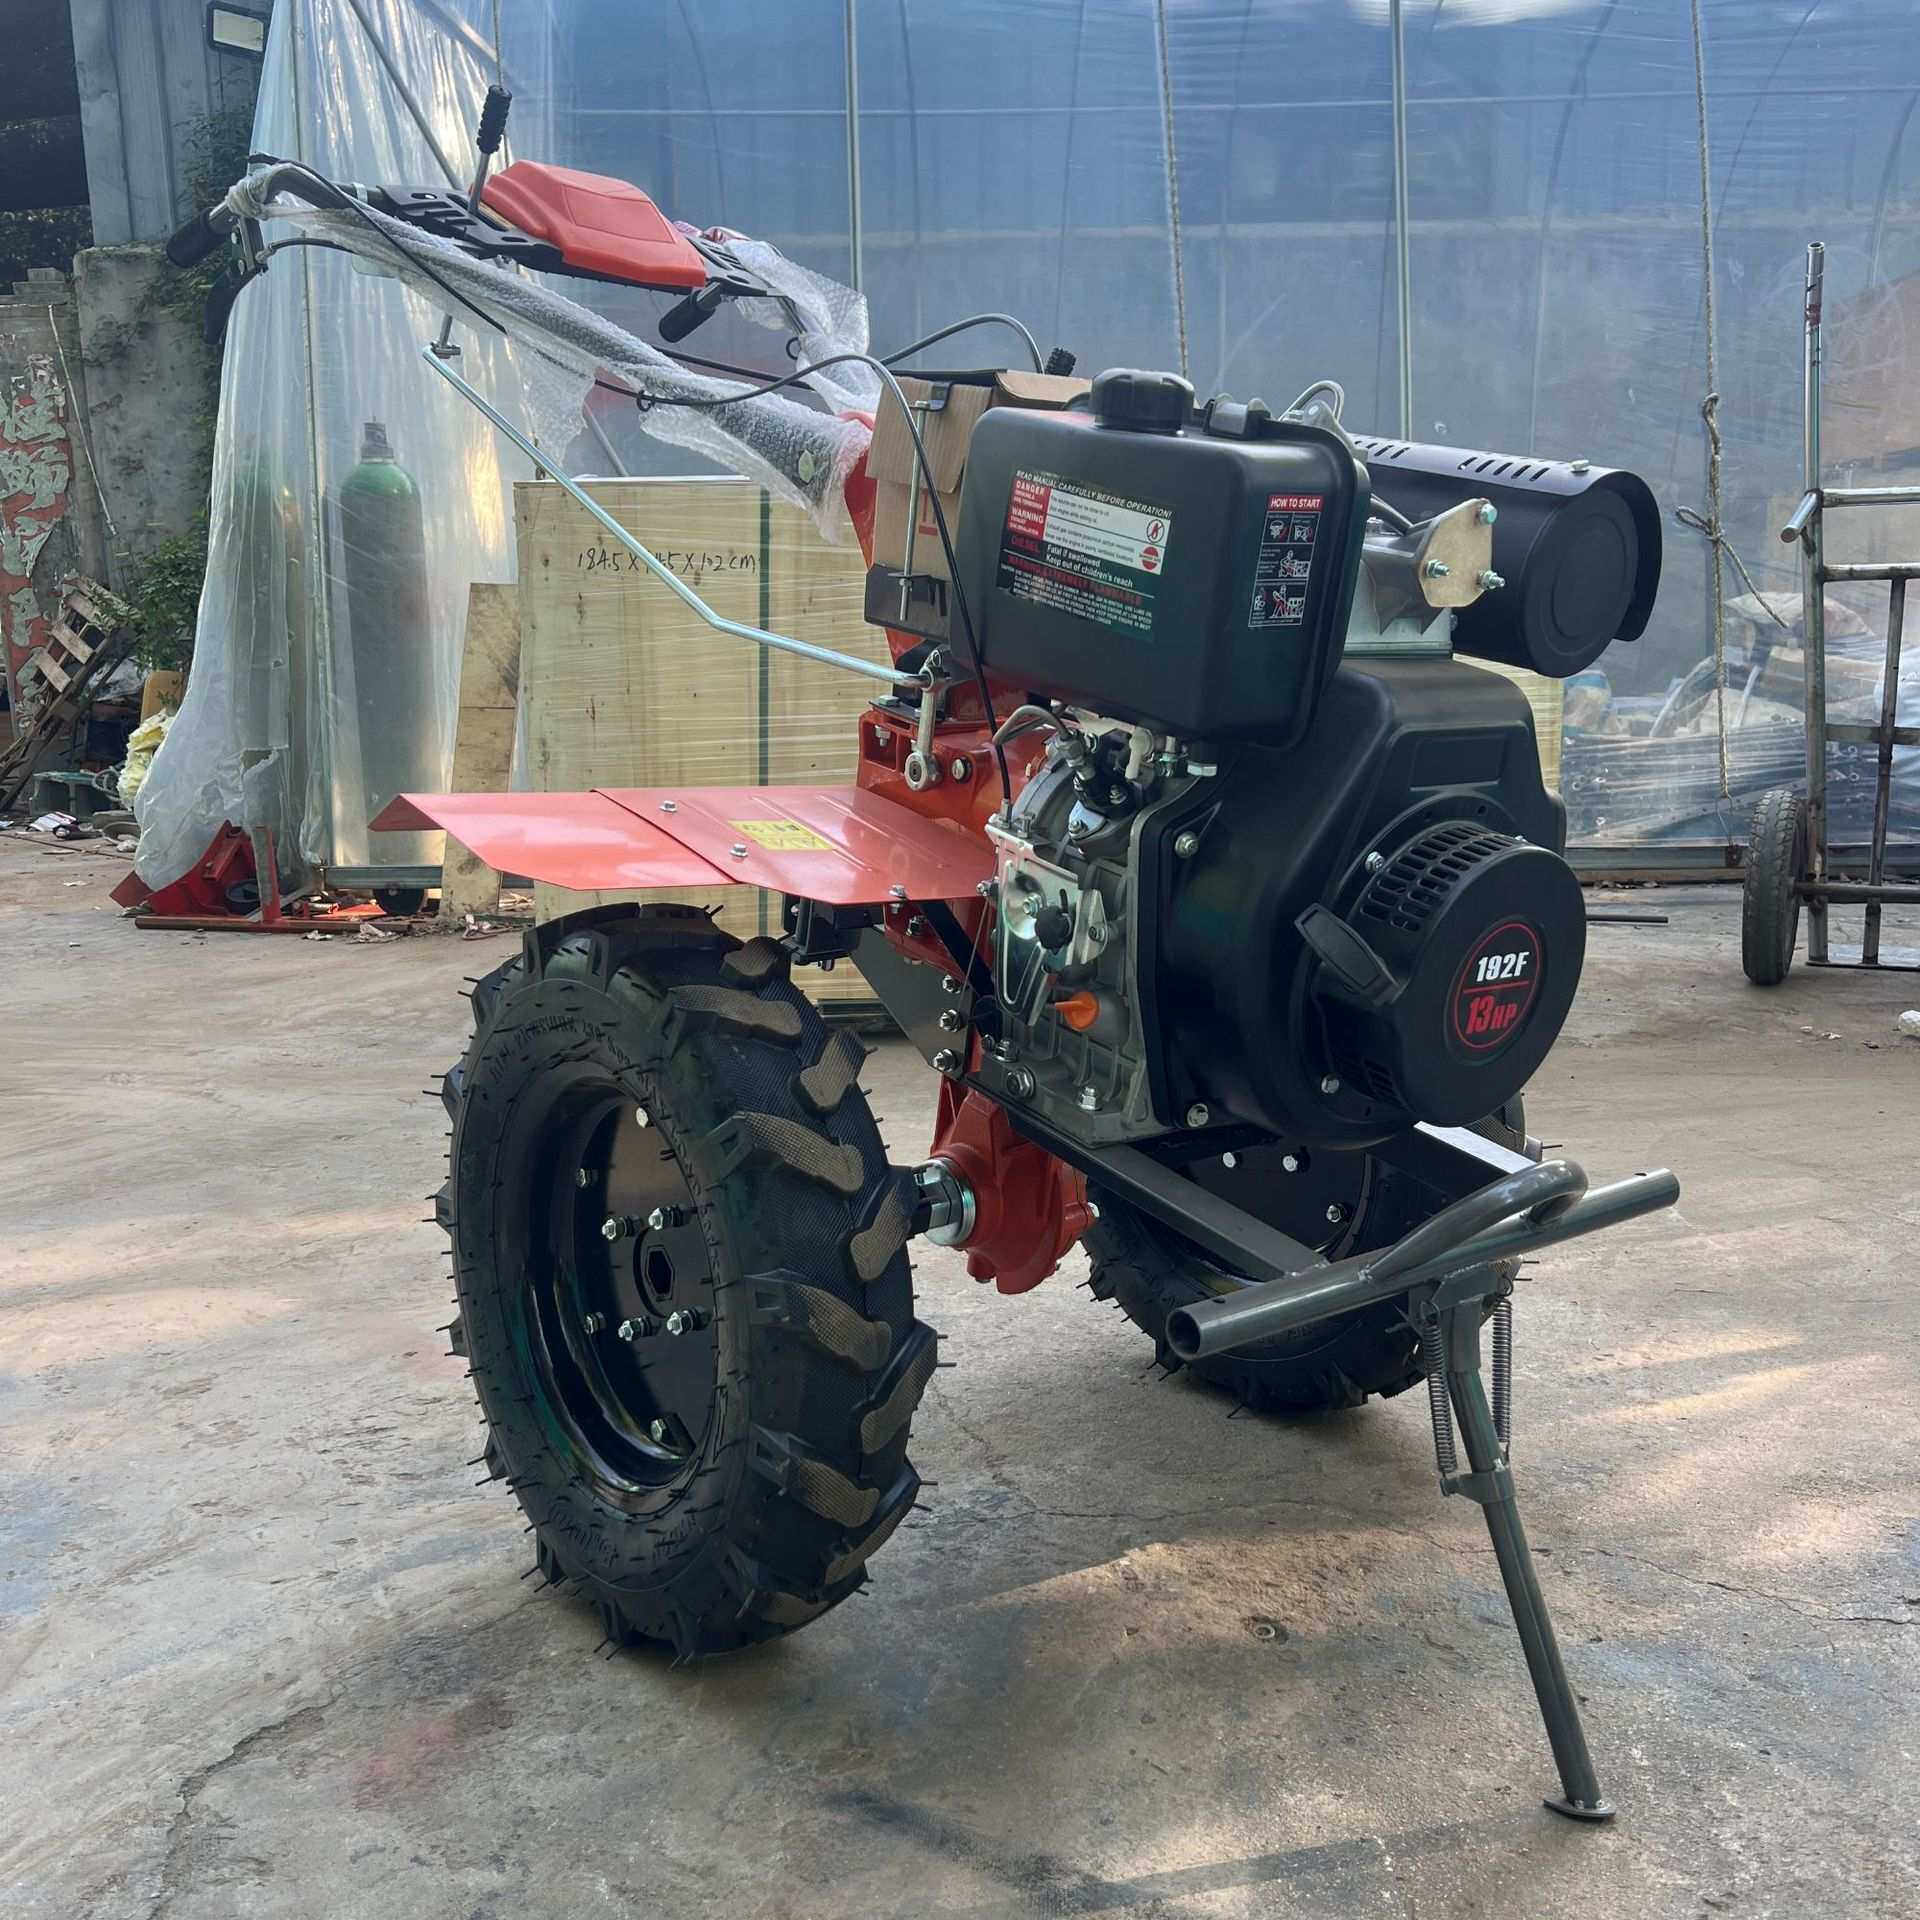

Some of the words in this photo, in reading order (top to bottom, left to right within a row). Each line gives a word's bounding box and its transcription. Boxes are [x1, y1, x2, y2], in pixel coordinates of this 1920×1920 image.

[1015, 480, 1045, 495] DANGER
[1033, 475, 1057, 487] MANUAL
[1058, 482, 1096, 499] CAREFULLY
[1096, 492, 1124, 506] BEFORE
[1126, 500, 1171, 519] OPERATION!
[1011, 507, 1043, 524] WARNING
[1271, 498, 1287, 508] HOW
[1288, 498, 1298, 508] TO
[1299, 498, 1320, 508] START
[1046, 544, 1062, 555] Fatal
[1068, 550, 1100, 567] swallowed
[1045, 553, 1062, 567] Keep
[1061, 560, 1072, 569] out
[1073, 562, 1081, 571] of
[1080, 564, 1112, 581] children's
[1113, 574, 1133, 587] reach
[1476, 952, 1529, 982] 192F
[1466, 995, 1518, 1034] 13HP
